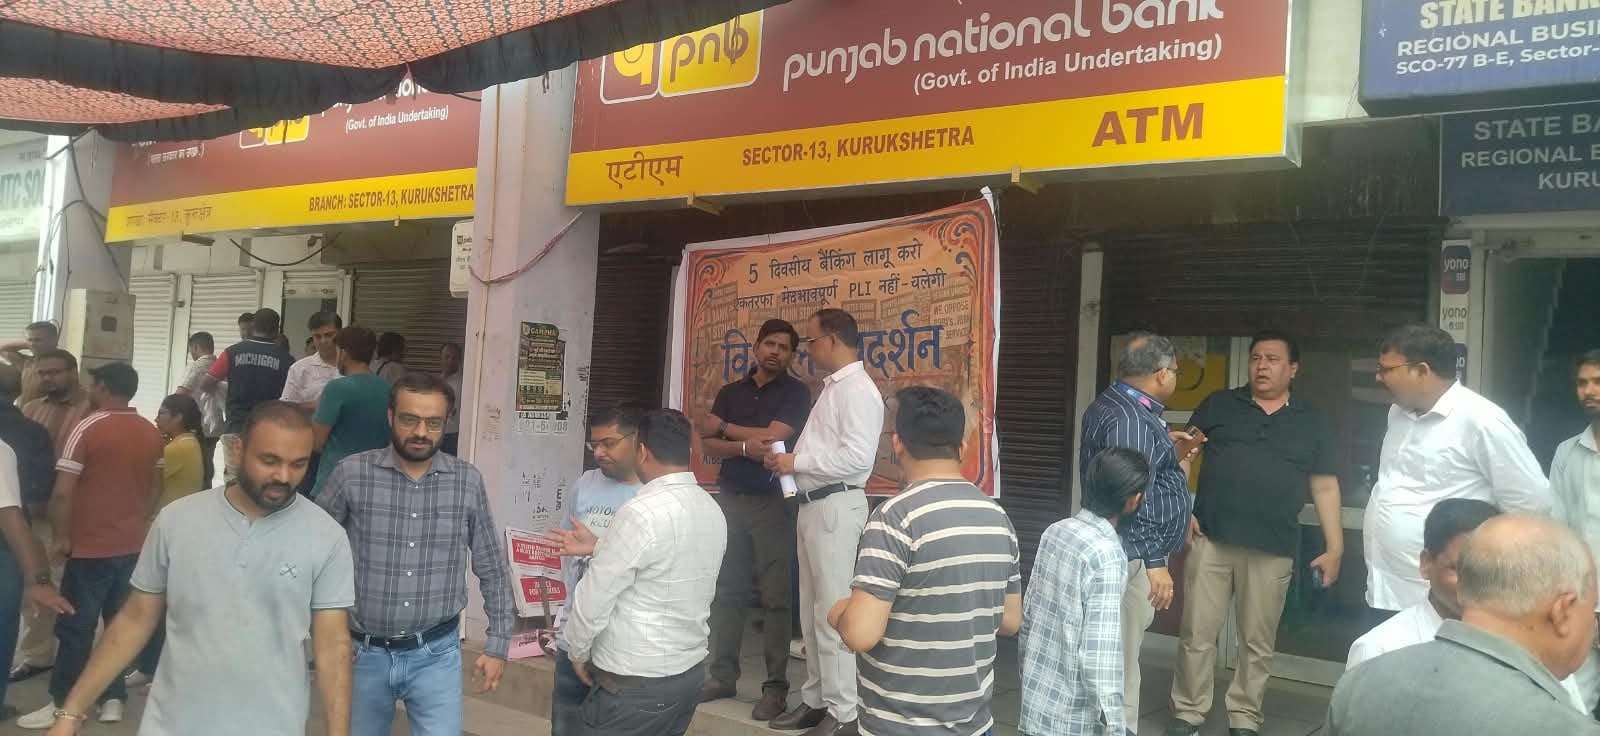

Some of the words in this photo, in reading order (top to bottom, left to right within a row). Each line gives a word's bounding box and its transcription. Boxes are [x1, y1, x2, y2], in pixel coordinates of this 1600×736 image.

[1420, 0, 1504, 29] STATE
[784, 28, 907, 91] punjab
[913, 0, 1091, 61] national
[1397, 29, 1524, 57] REGIONAL
[1531, 19, 1600, 42] BUSI
[914, 69, 972, 96] (Govt.
[978, 63, 1000, 83] of
[1004, 59, 1057, 81] India
[1064, 34, 1222, 73] Undertaking)
[1396, 55, 1468, 75] SCO-77
[1473, 51, 1514, 67] B-E,
[1519, 43, 1600, 63] Sector-
[346, 118, 366, 134] (Govt.
[369, 113, 377, 128] of
[378, 112, 396, 127] India
[398, 105, 449, 124] Undertaking)
[1092, 103, 1205, 147] ATM
[1474, 116, 1561, 140] STATE
[742, 140, 832, 166] SECTOR-13,
[837, 125, 975, 158] KURUKSHETRA
[1461, 145, 1583, 168] REGIONAL
[606, 151, 684, 190] एटीएम
[309, 194, 346, 212] BRANCH:
[348, 189, 399, 209] SECTOR-13,
[401, 184, 475, 206] KURUKSHETRA
[749, 263, 759, 284] 5
[768, 255, 812, 280] दिवसीय
[818, 248, 856, 271] बैंकिंग
[864, 248, 896, 268] लागू
[897, 237, 923, 260] करो
[1443, 257, 1469, 272] yono
[849, 281, 872, 299] PLI
[877, 273, 901, 296] नहीं
[1442, 307, 1468, 321] yono
[234, 353, 280, 370] MICHIGAN
